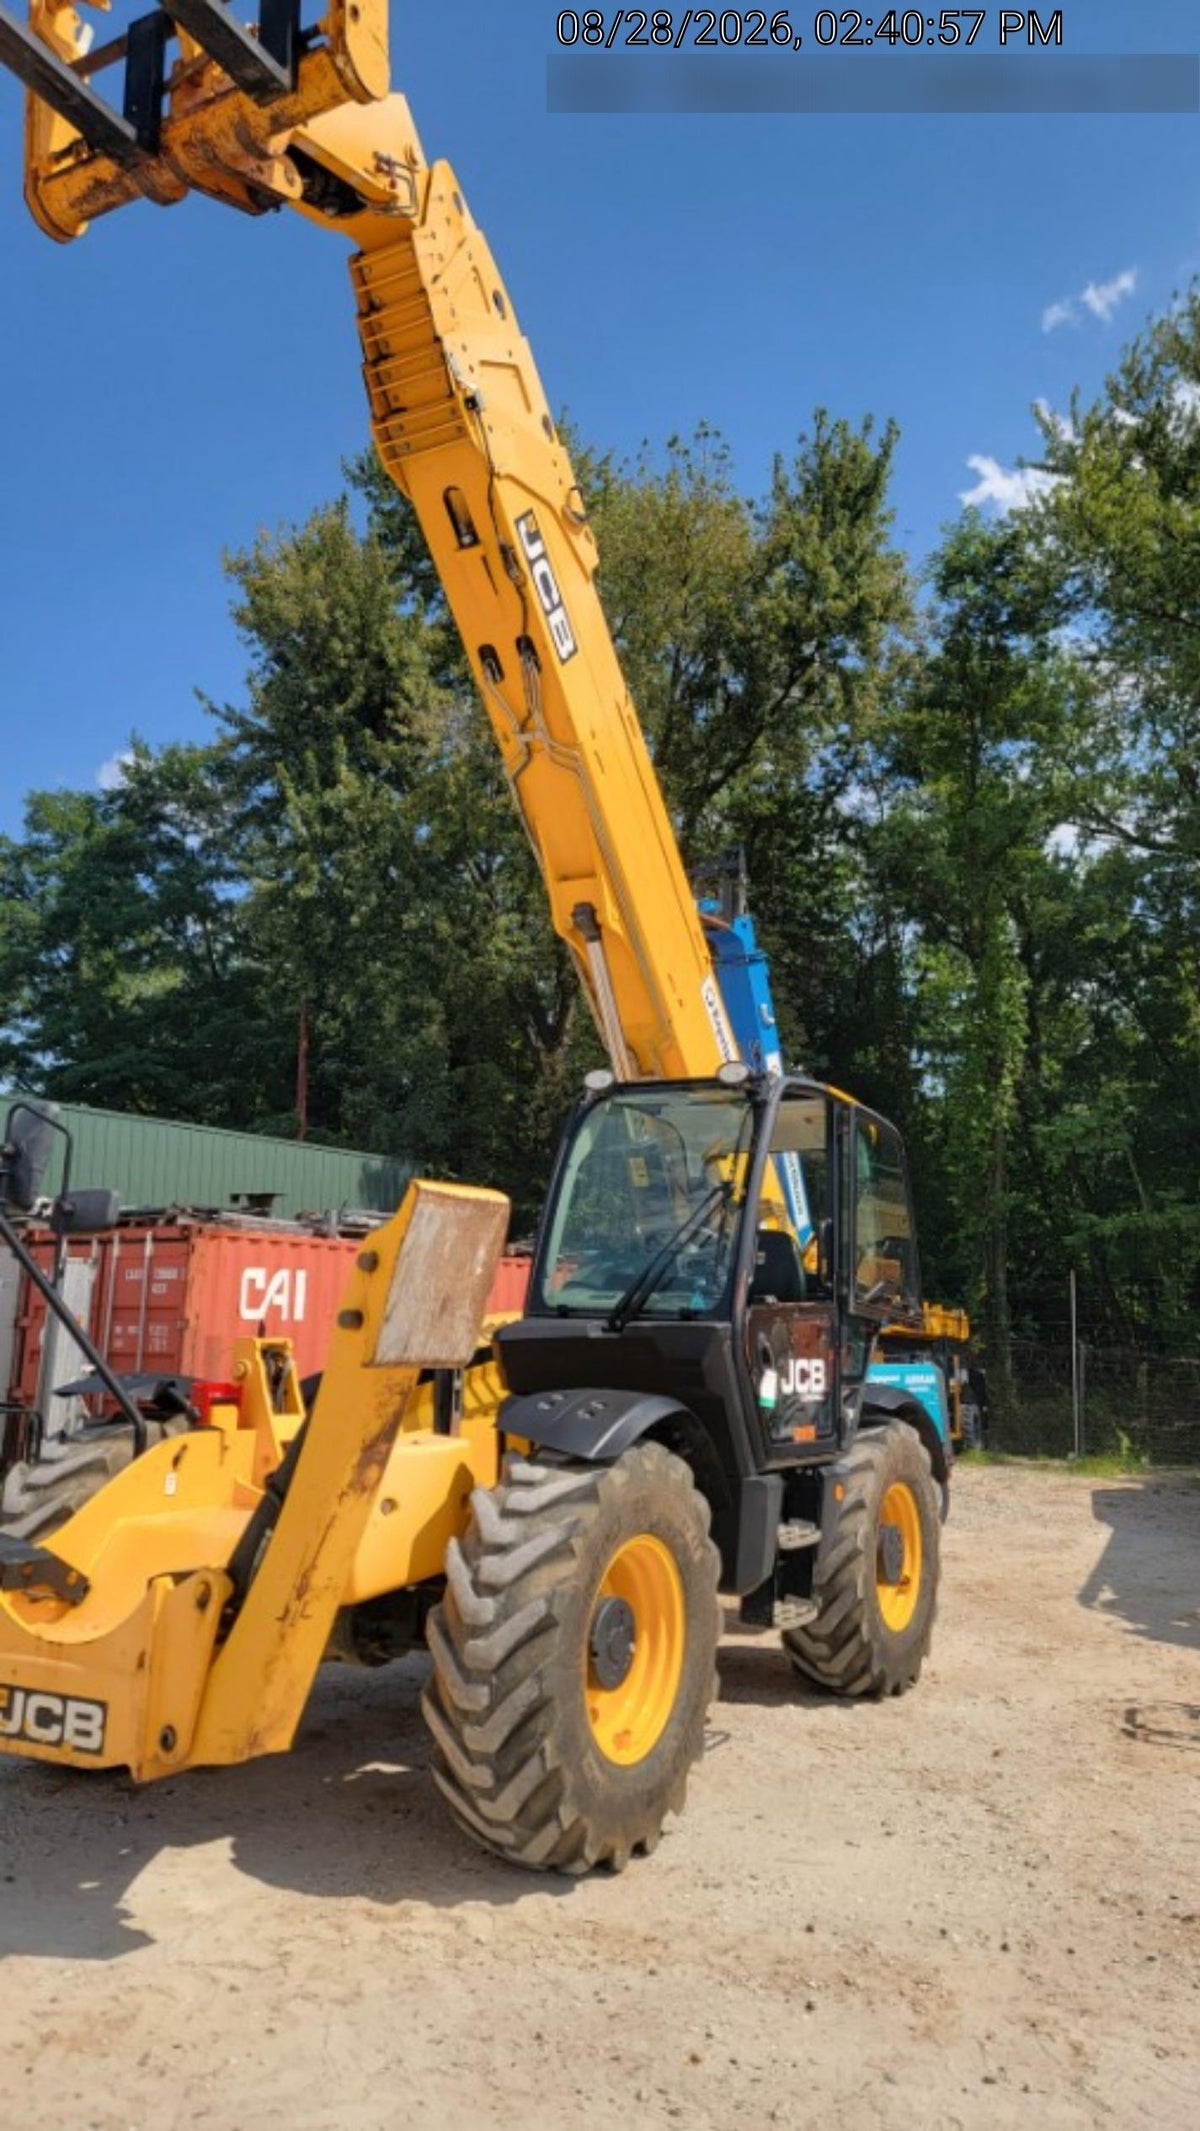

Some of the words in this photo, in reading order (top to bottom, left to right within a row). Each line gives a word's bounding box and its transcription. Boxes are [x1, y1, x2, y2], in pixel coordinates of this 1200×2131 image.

[517, 519, 576, 662] JCB
[240, 1267, 307, 1321] CAI
[780, 1358, 825, 1395] JCB
[0, 1690, 104, 1750] JCB
